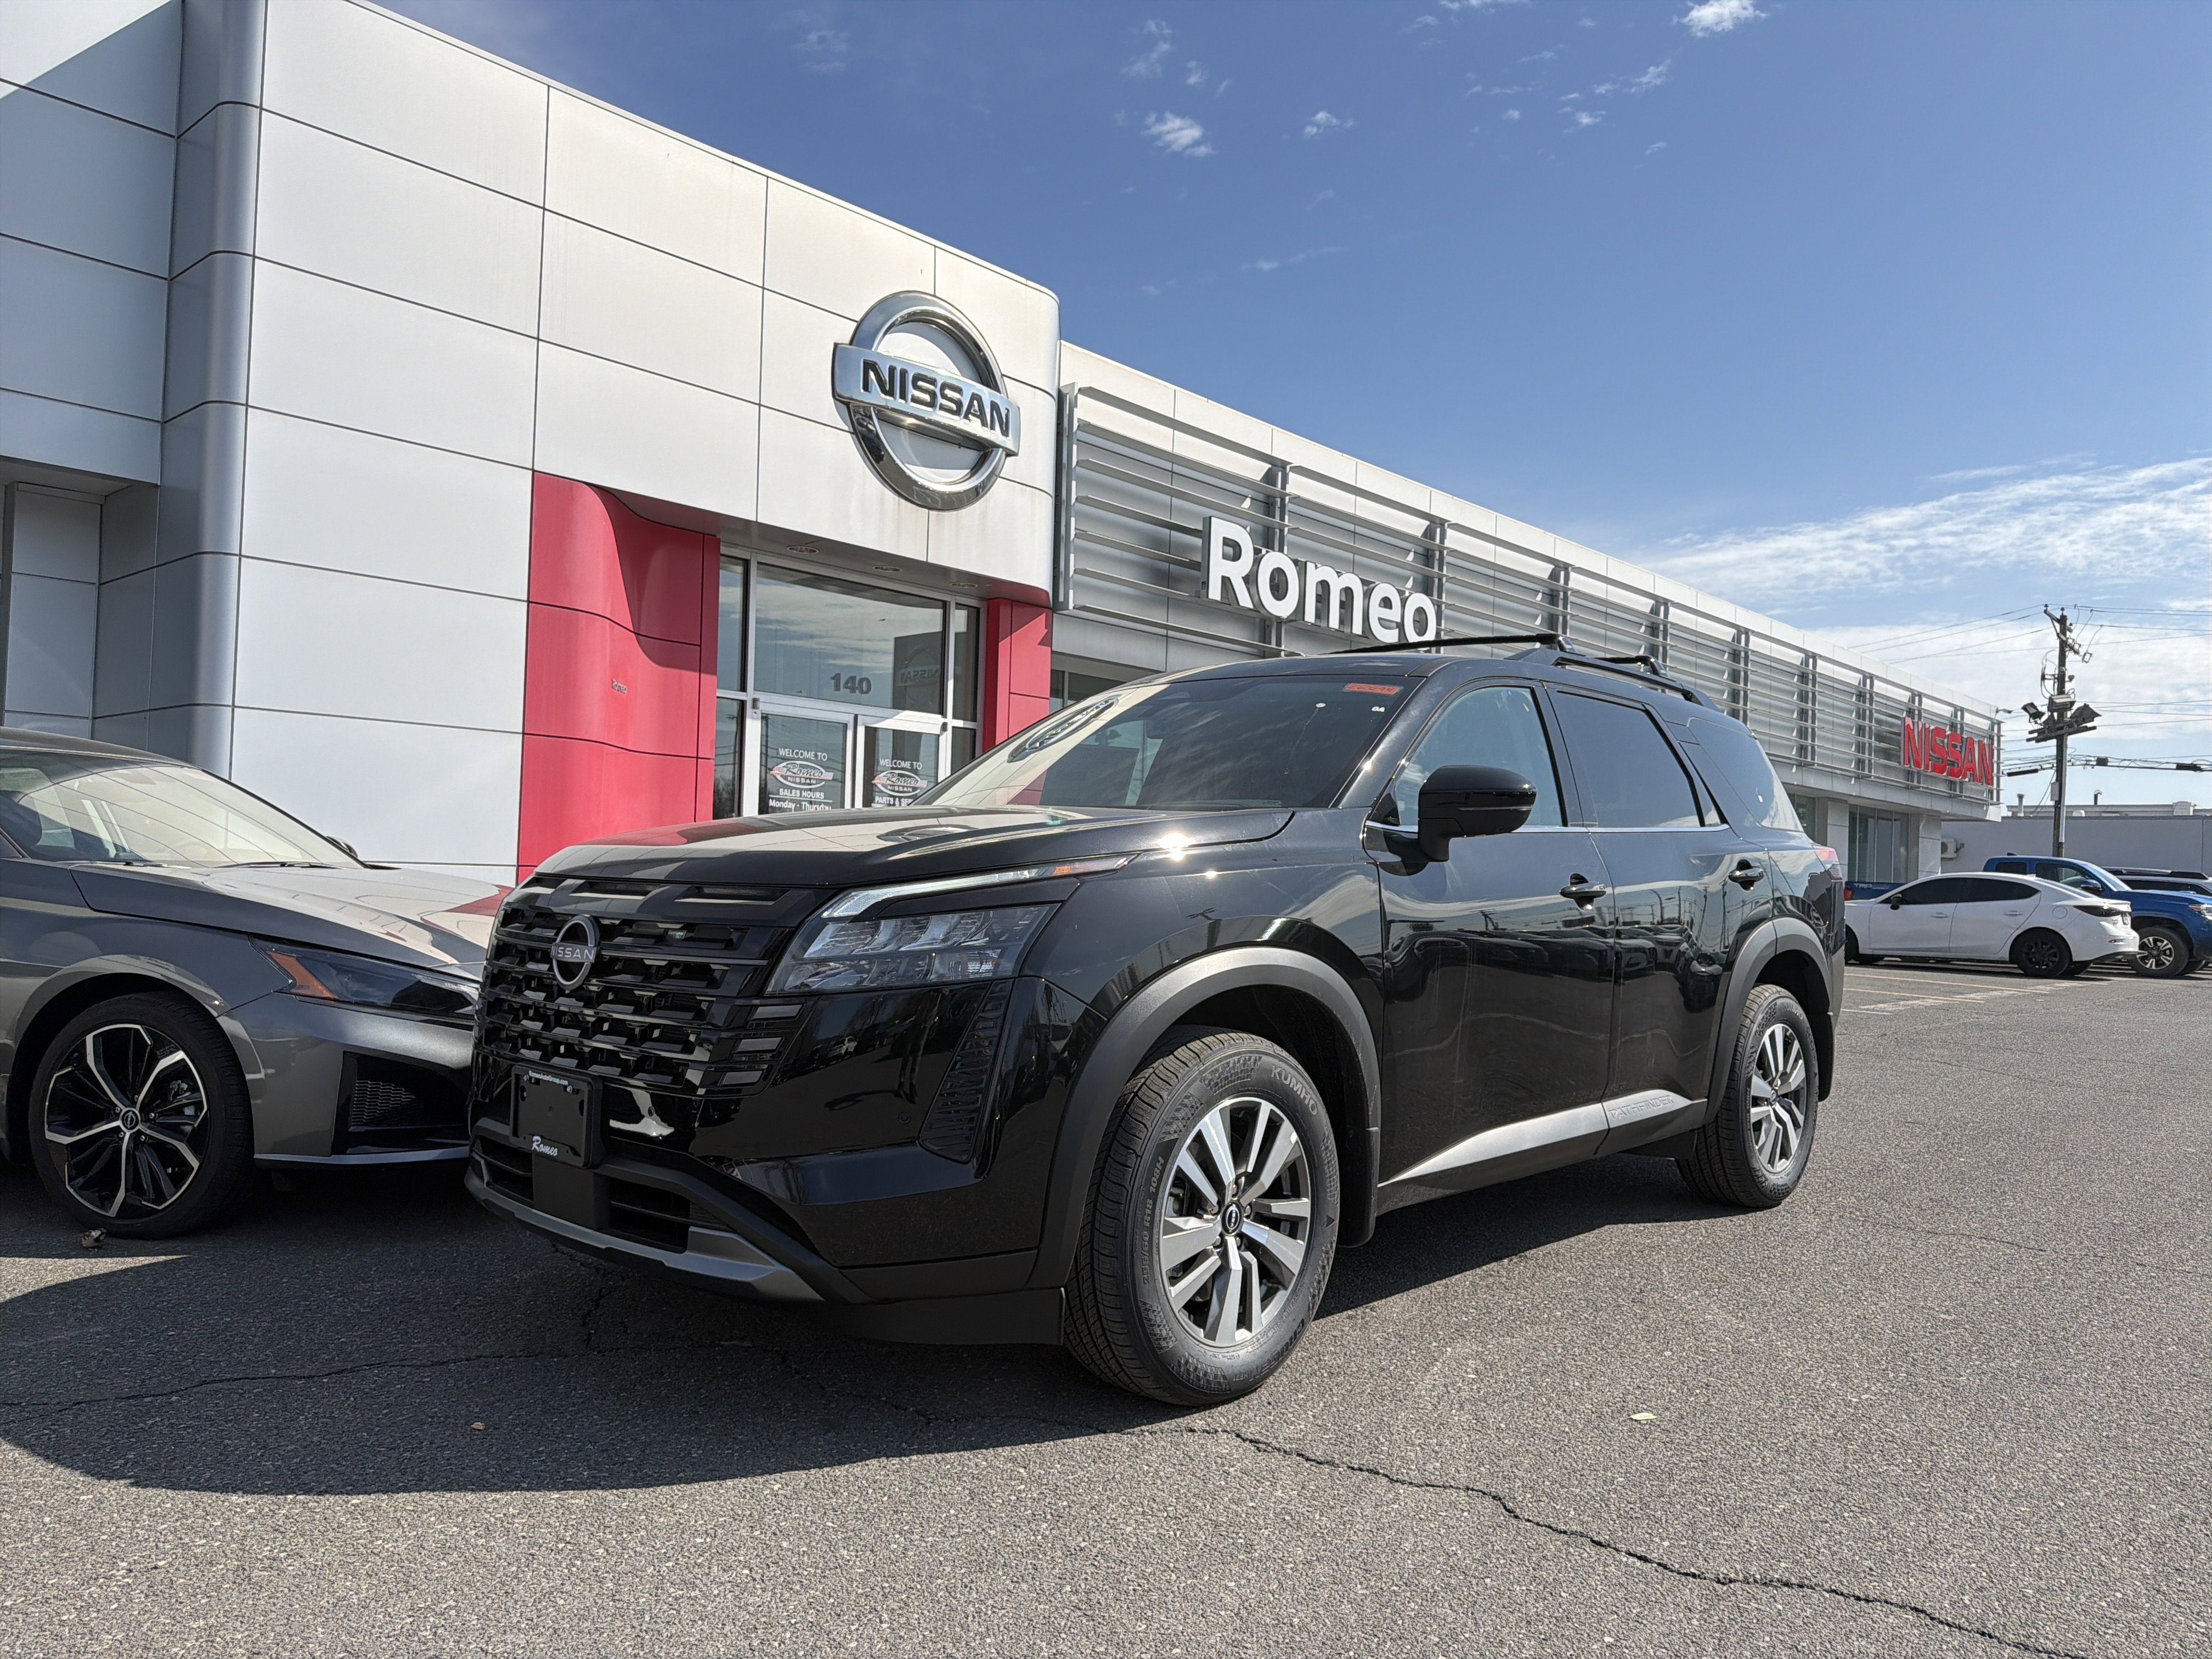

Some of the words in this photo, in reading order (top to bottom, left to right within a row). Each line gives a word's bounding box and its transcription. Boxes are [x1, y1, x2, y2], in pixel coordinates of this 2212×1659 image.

[861, 359, 1011, 441] NISSAN
[1206, 516, 1436, 650] Romeo
[830, 673, 871, 695] 140
[779, 748, 815, 760] WELCOME
[816, 752, 827, 761] TO
[1904, 716, 1993, 787] NISSAN
[782, 763, 823, 778] Romeo
[879, 759, 911, 769] WELCOME
[912, 761, 922, 770] TO
[883, 772, 918, 785] Romeo
[779, 788, 800, 797] SALES
[802, 791, 825, 799] HOURS
[875, 796, 893, 804] PARTS
[769, 799, 795, 812] Monday
[551, 945, 594, 960] NISSAN
[1271, 1064, 1317, 1115] KUMHO
[1608, 1095, 1674, 1119] PATHFINDER
[532, 1136, 558, 1156] Romeo
[1143, 1199, 1153, 1227] R18
[1150, 1156, 1164, 1193] 108H
